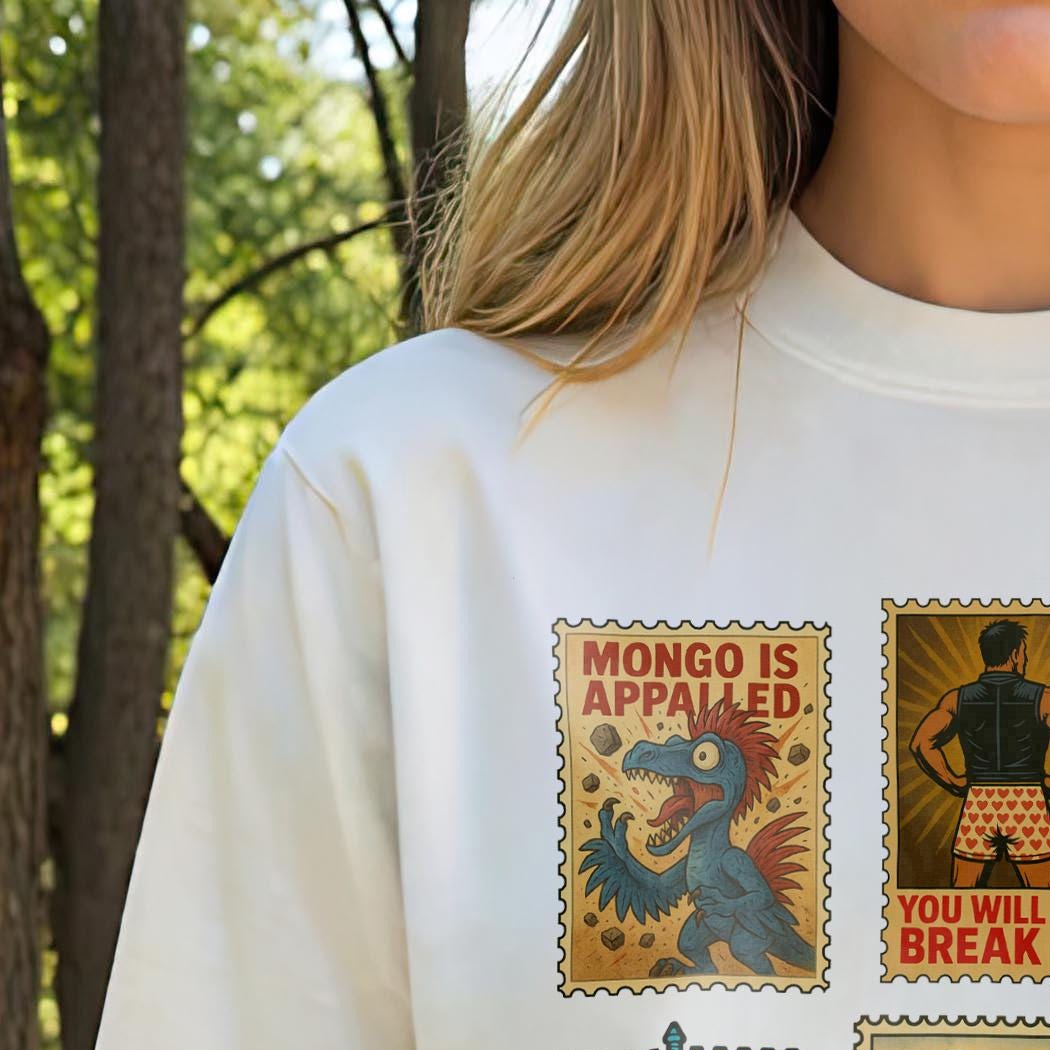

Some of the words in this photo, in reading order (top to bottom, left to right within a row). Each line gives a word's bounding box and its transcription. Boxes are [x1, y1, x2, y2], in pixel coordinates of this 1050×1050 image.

[583, 641, 744, 678] MONGO
[759, 643, 799, 678] IS
[897, 895, 962, 923] YOU
[971, 895, 1046, 924] WILL
[900, 927, 1042, 965] BREAK
